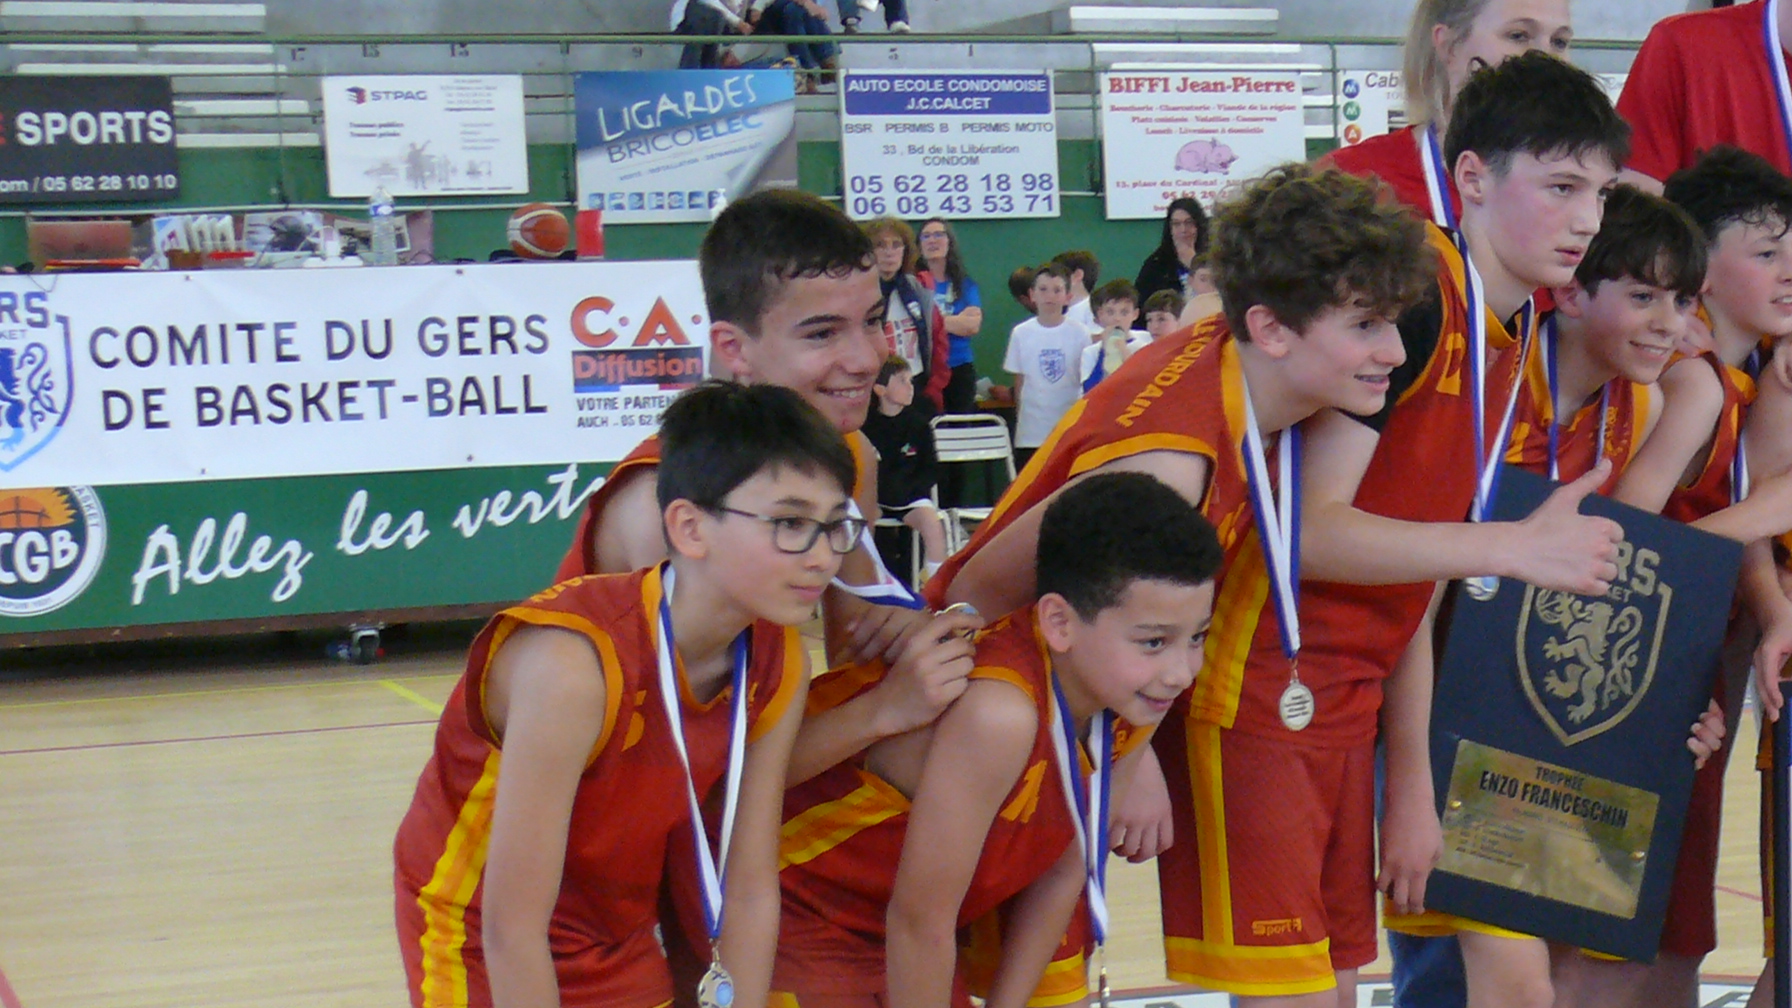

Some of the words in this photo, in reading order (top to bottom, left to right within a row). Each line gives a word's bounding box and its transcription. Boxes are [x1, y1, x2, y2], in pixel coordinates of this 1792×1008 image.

[848, 79, 890, 93] AUTO
[894, 79, 944, 93] ECOLE
[948, 79, 1047, 92] CONDOMOISE
[1108, 77, 1170, 93] BIFFI
[1176, 77, 1296, 93] Jean-Pierre
[598, 74, 757, 142] LIGARDES
[905, 97, 992, 110] J.C.CALCET
[15, 110, 173, 146] SPORTS
[607, 112, 765, 163] BRICOELEC
[845, 123, 872, 133] BSR
[885, 122, 935, 133] PERMIS
[939, 123, 949, 133] B
[961, 122, 1010, 132] PERMIS
[1015, 122, 1054, 132] MOTO
[882, 145, 897, 155] 33
[907, 144, 925, 155] Bd
[928, 145, 943, 155] de
[946, 144, 957, 154] la
[960, 144, 1020, 154] Libération
[922, 155, 980, 166] CONDOM
[43, 176, 67, 191] 05
[71, 175, 95, 191] 62
[98, 175, 122, 190] 28
[126, 174, 150, 190] 10
[154, 174, 177, 189] 10
[850, 175, 884, 194] 05
[894, 174, 927, 194] 62
[936, 174, 969, 192] 28
[980, 173, 1011, 192] 18
[1021, 173, 1054, 192] 98
[853, 196, 886, 215] 06
[896, 196, 929, 215] 08
[939, 195, 972, 214] 43
[983, 195, 1015, 214] 53
[1024, 194, 1054, 213] 71
[89, 321, 300, 369] COMITE
[325, 317, 393, 361] DU
[417, 314, 550, 358] GERS
[573, 352, 702, 384] Diffusion
[102, 387, 170, 432] DE
[195, 373, 549, 428] BASKET-BALL
[577, 397, 619, 411] VOTRE
[577, 416, 609, 428] AUCH
[131, 512, 314, 606] Allez
[337, 489, 431, 557] les
[1616, 541, 1661, 597] RS
[1479, 770, 1520, 799] ENZO
[1521, 781, 1629, 829] FRANCESCHIN
